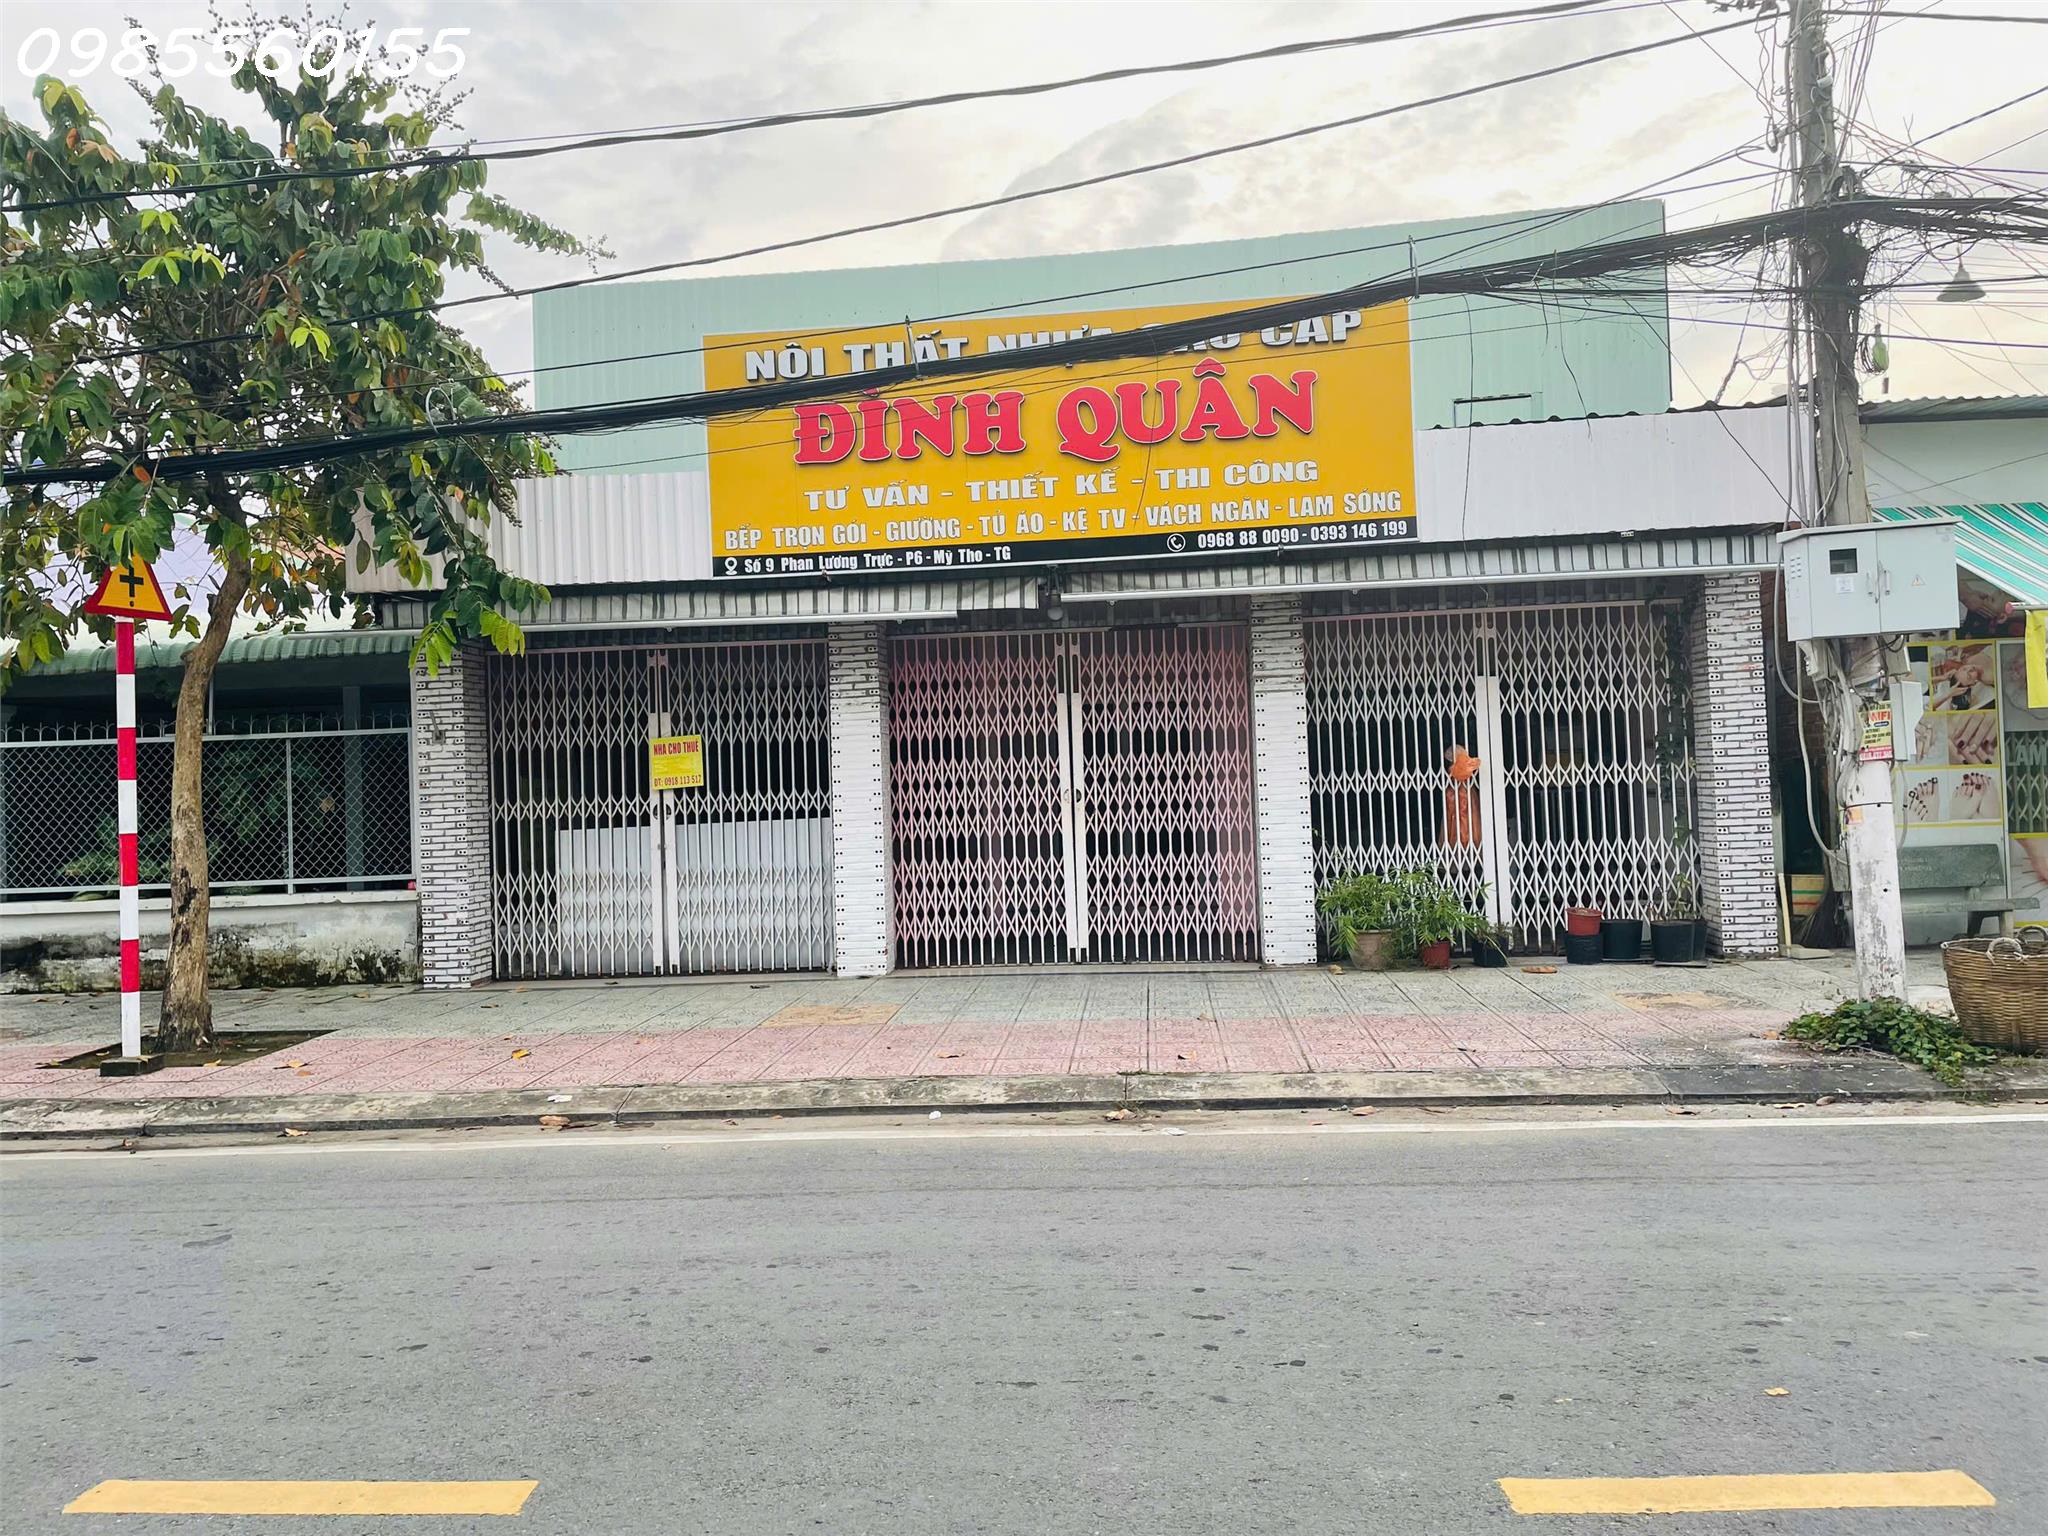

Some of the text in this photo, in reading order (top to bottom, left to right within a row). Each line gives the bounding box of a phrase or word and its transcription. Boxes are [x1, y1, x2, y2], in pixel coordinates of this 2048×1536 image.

[843, 330, 968, 371] THẤT
[1056, 357, 1319, 462] QUÂN
[804, 486, 850, 510] TƯ
[862, 479, 929, 507] VẤN
[965, 471, 1059, 500] THIẾT
[1076, 466, 1118, 496] KẾ
[1154, 467, 1211, 491] THI
[1223, 459, 1319, 486] CÔNG
[724, 523, 762, 550] BẾP
[772, 525, 825, 550] TRỌN
[832, 519, 867, 545] GÓI
[886, 516, 961, 542] GIƯỜNG
[1016, 510, 1044, 534] ÁO
[1098, 509, 1126, 530] TV
[1145, 501, 1202, 526] VÁCH
[1211, 496, 1270, 523] NGĂN
[1289, 495, 1334, 518] LAM
[1344, 488, 1401, 515] SÓNG
[1197, 532, 1235, 548] 0968
[1239, 531, 1258, 546] 88
[1262, 528, 1299, 544] 0090
[1310, 524, 1347, 541] 0393
[1351, 522, 1377, 538] 146
[1381, 520, 1408, 536] 199
[744, 557, 762, 573] Số
[765, 557, 775, 572] 9
[781, 557, 814, 572] Phan
[818, 555, 858, 571] Lương
[905, 550, 923, 565] P6
[958, 548, 983, 563] Tho
[993, 545, 1011, 560] TG
